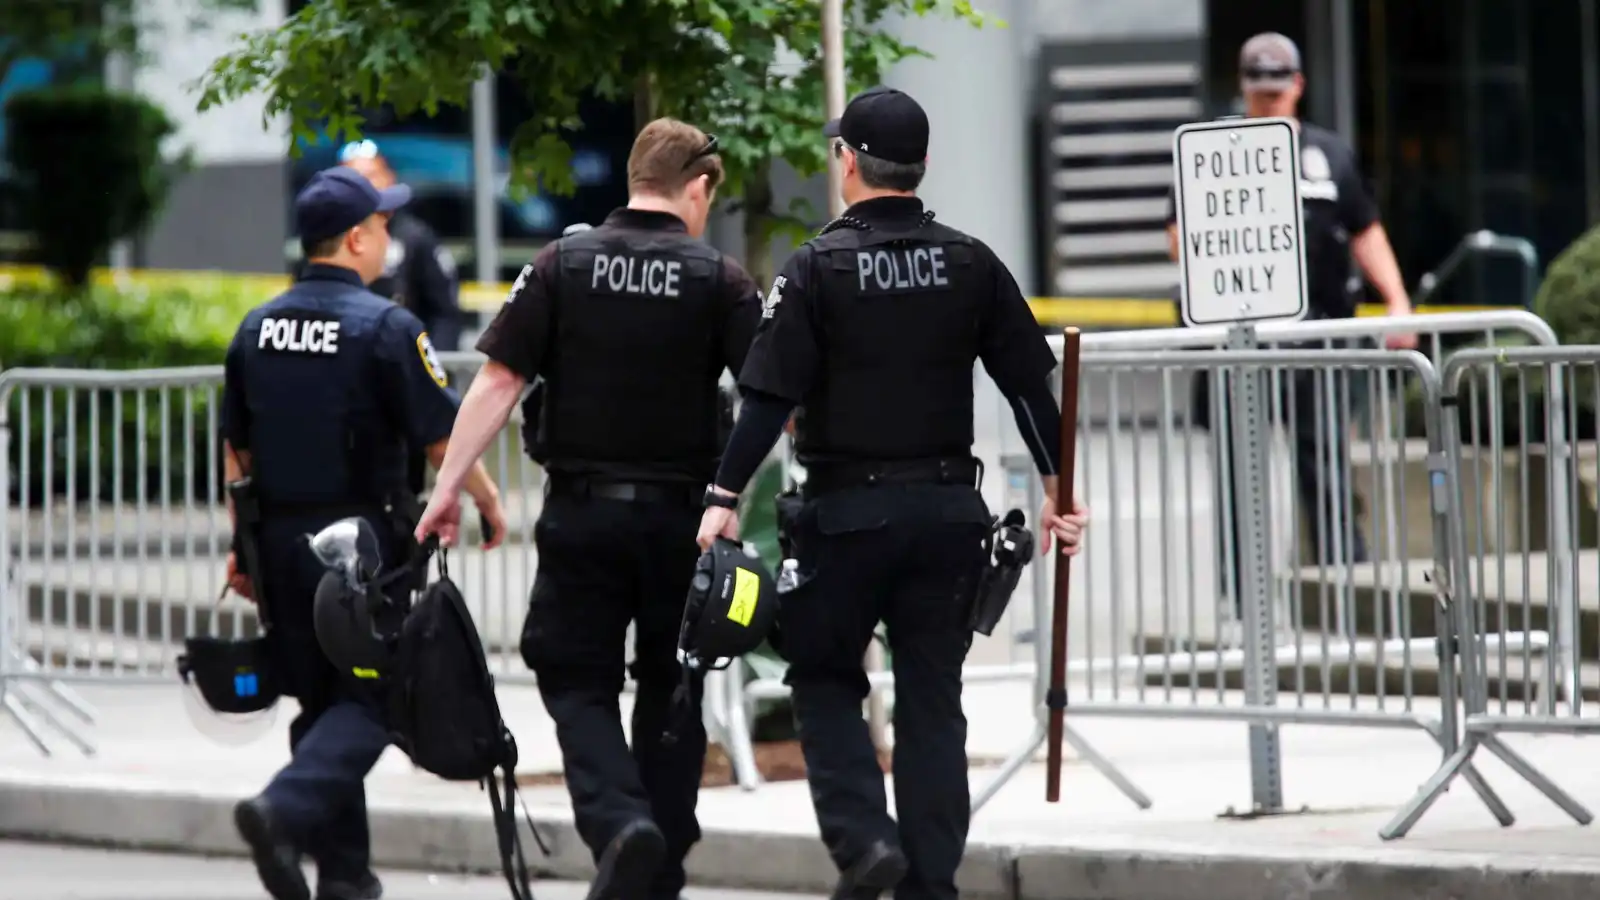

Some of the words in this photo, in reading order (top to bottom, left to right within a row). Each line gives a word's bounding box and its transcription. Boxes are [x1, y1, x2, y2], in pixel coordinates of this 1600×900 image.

[1194, 146, 1283, 179] POLICE
[1206, 187, 1276, 217] DEPT.
[1190, 223, 1293, 257] VEHICLES
[592, 253, 681, 297] POLICE
[857, 246, 948, 291] POLICE
[1213, 264, 1275, 295] ONLY
[258, 317, 341, 354] POLICE
